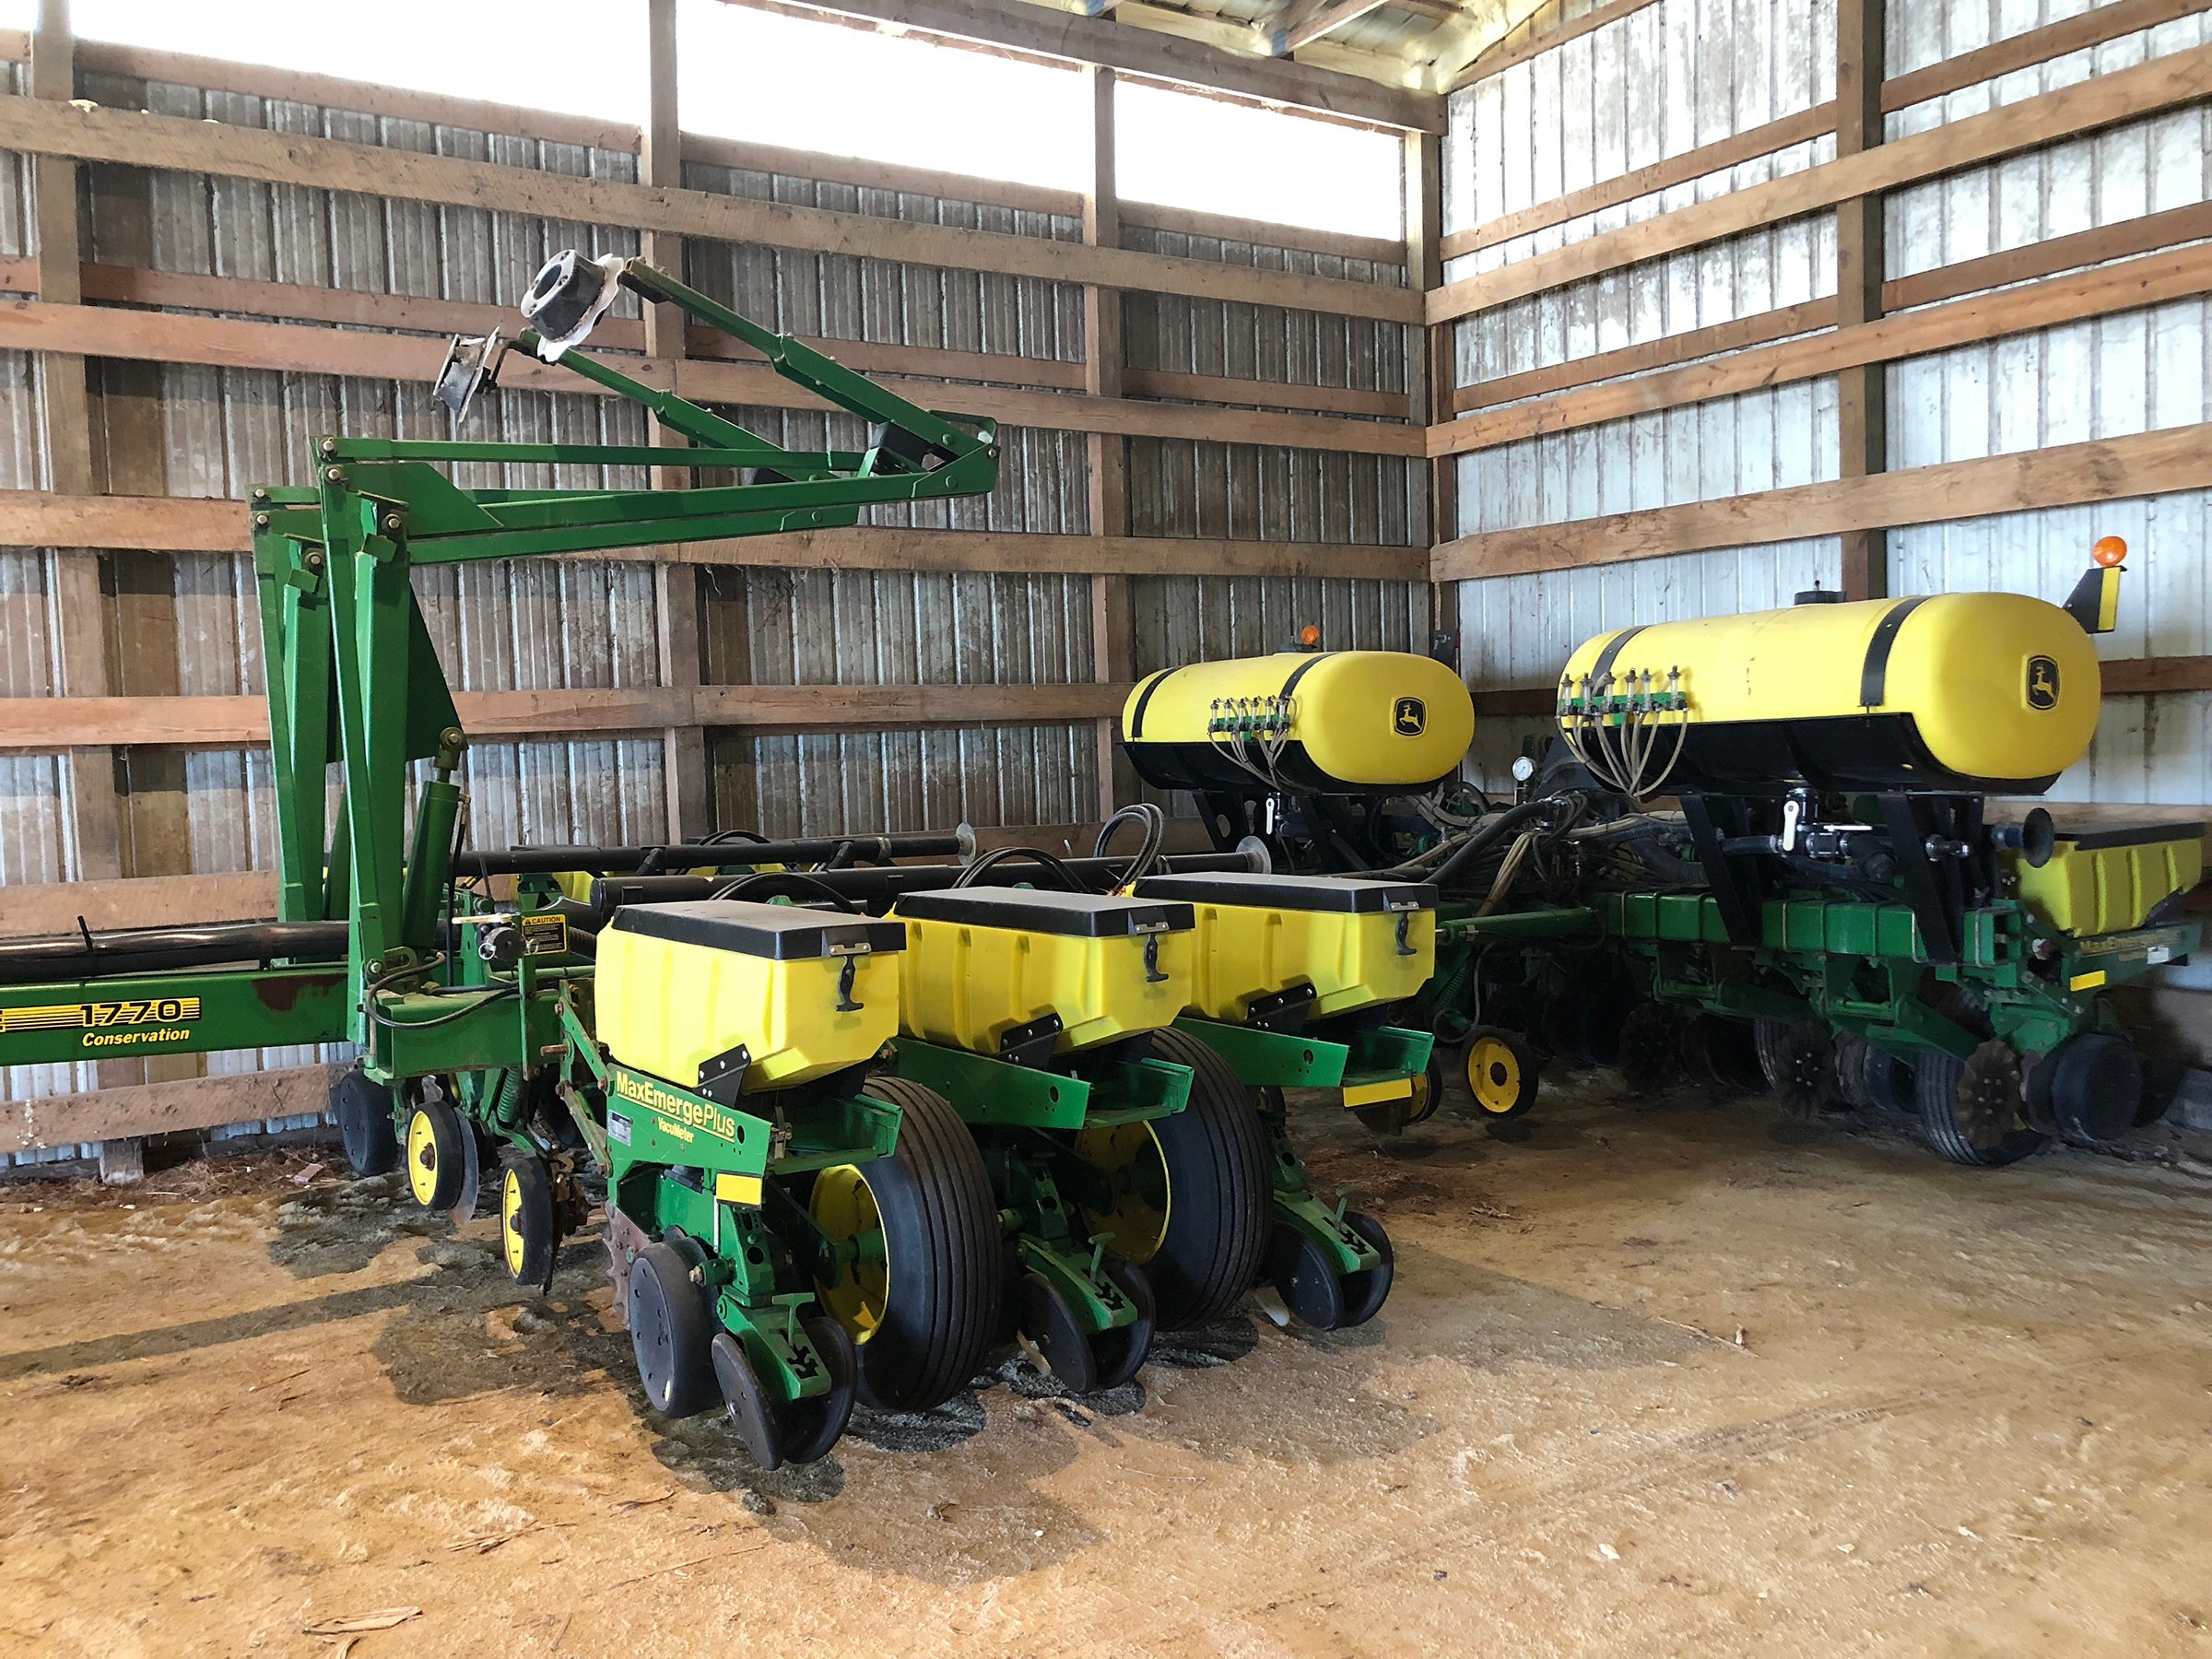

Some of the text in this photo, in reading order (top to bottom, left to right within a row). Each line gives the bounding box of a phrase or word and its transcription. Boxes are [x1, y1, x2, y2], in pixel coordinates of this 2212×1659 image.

[532, 916, 560, 924] CAUTION
[80, 1000, 182, 1026] 1770
[82, 1028, 190, 1047] Conservation
[617, 1071, 735, 1137] MaxEmergePlus
